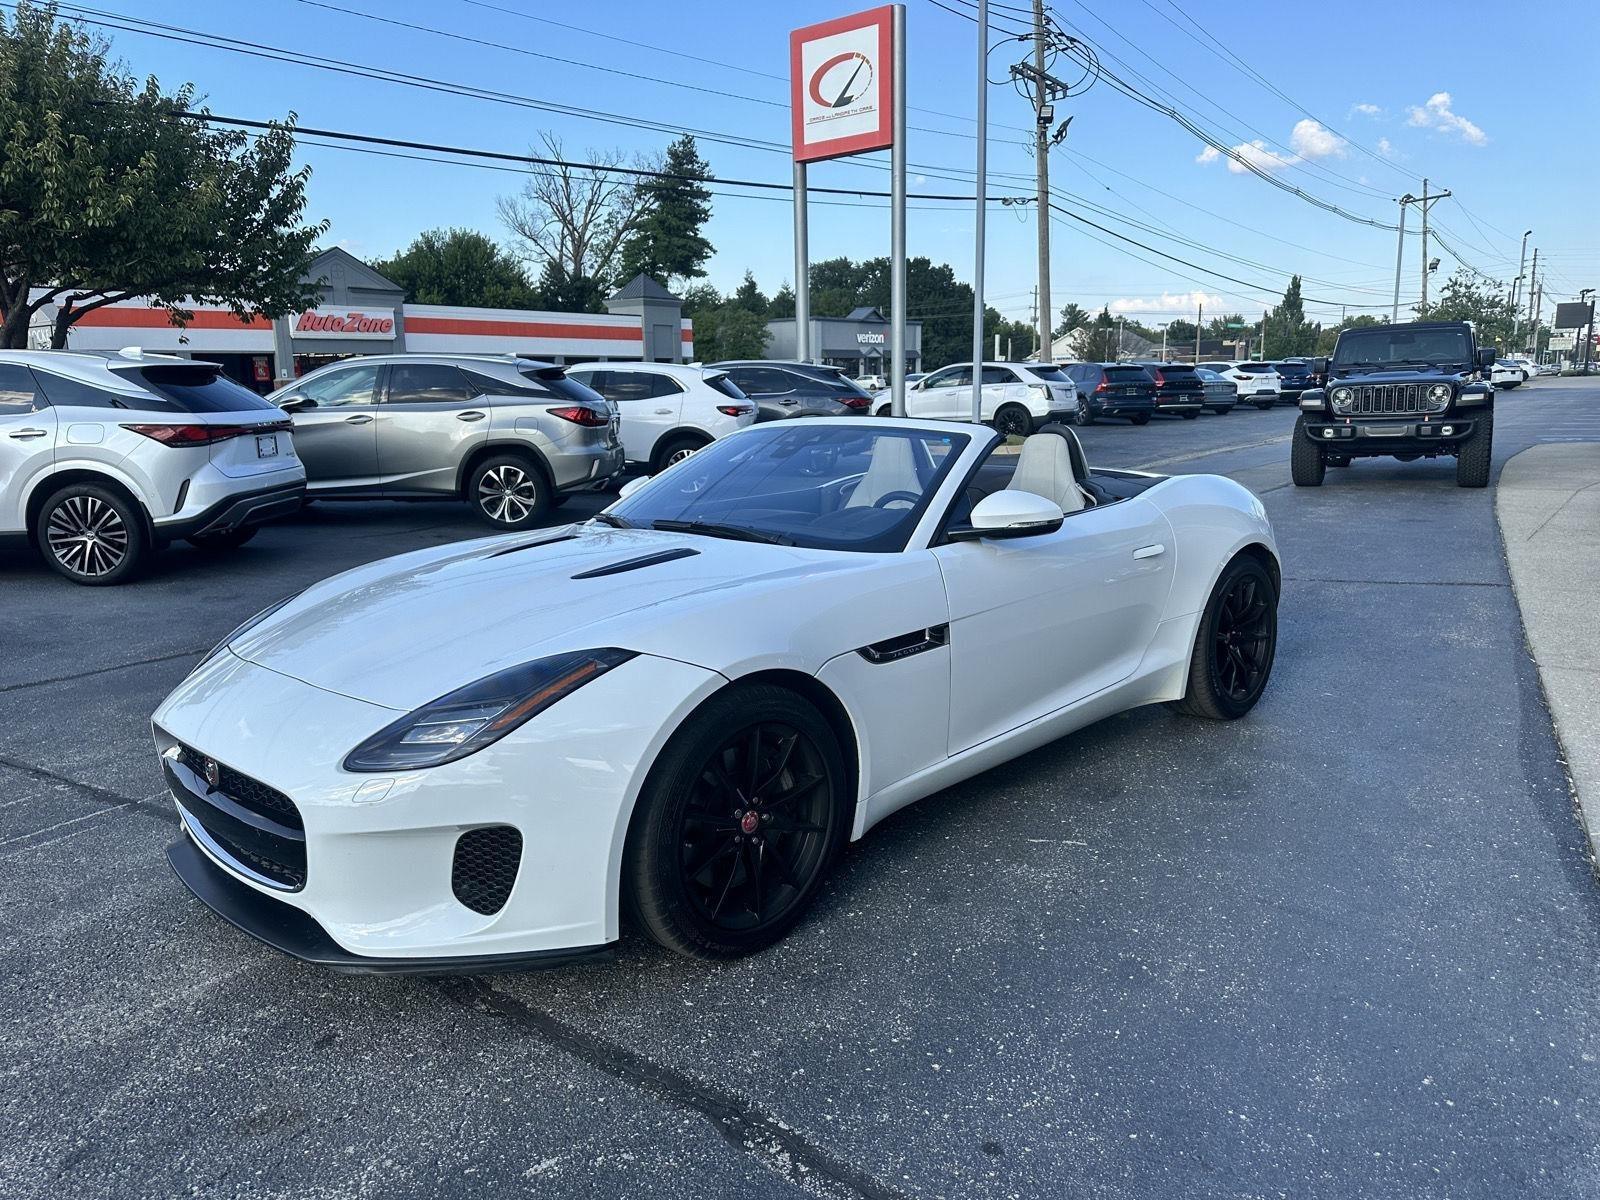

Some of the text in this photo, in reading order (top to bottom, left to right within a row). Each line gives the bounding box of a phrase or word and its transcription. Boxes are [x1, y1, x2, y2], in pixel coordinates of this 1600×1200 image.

[296, 312, 393, 333] AutoZone
[856, 331, 885, 344] verizon
[893, 645, 926, 658] JAGUAR
